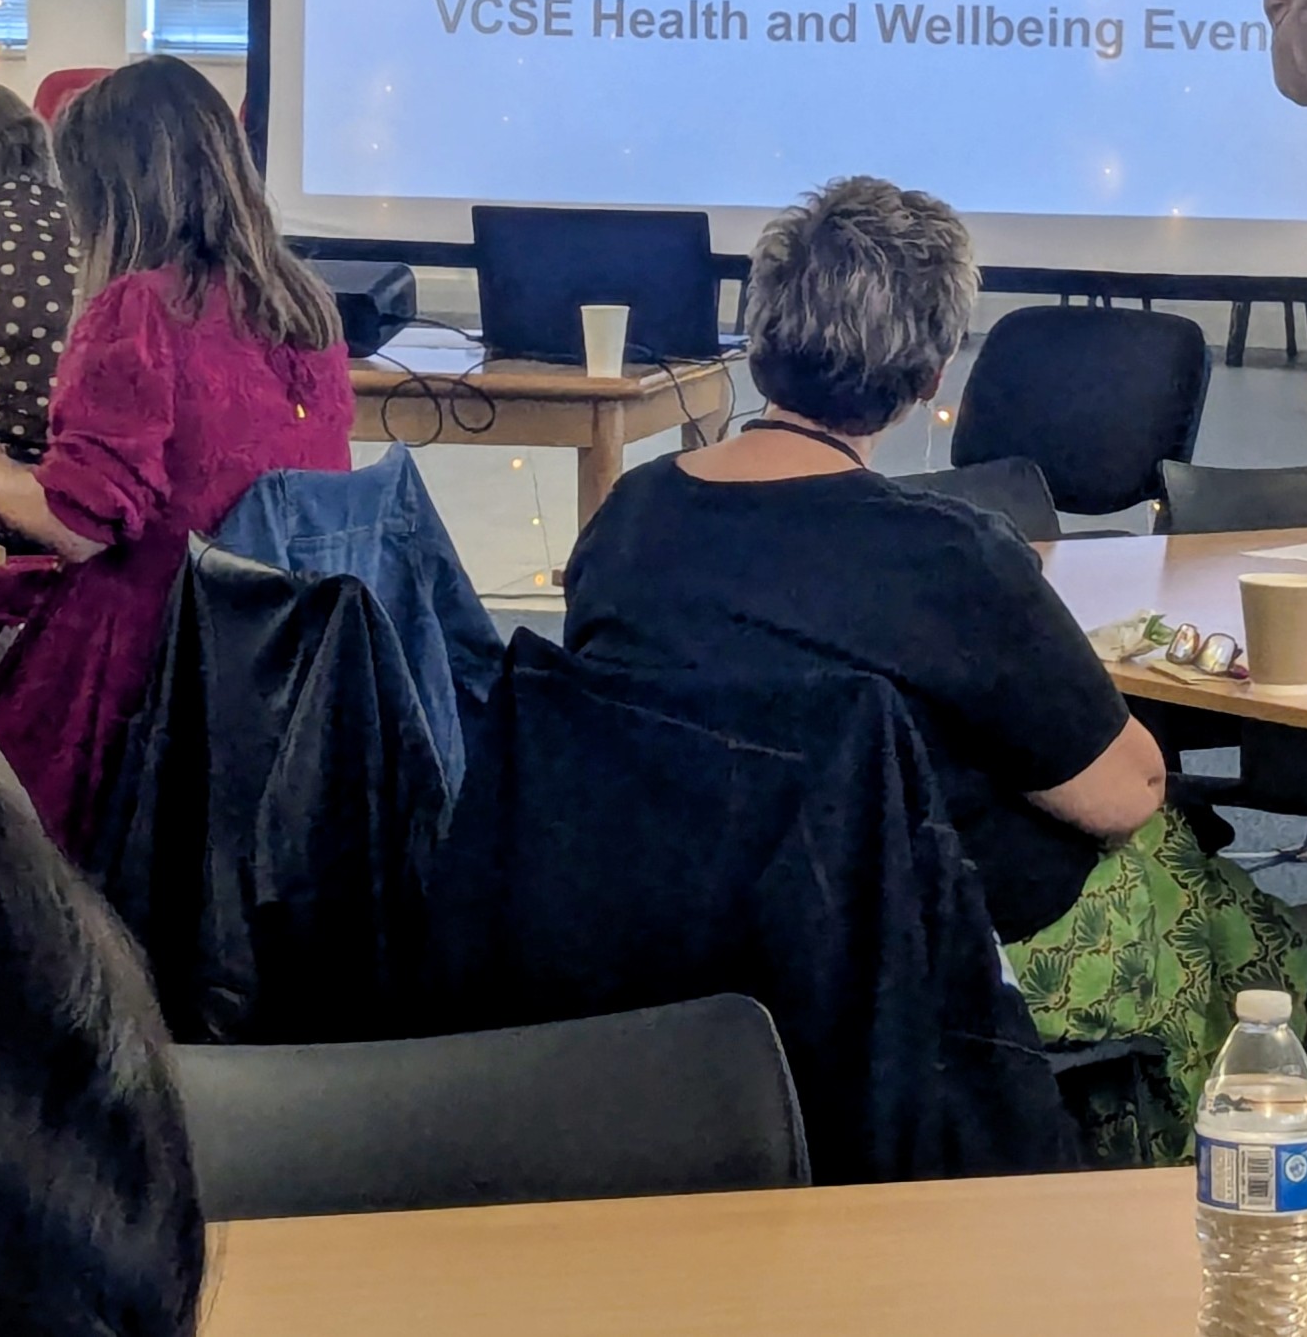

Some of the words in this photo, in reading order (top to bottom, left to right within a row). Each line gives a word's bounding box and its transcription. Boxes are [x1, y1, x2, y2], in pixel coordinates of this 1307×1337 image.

[766, 3, 857, 42] and
[875, 4, 1124, 58] Wellbeing
[1144, 9, 1267, 51] Even
